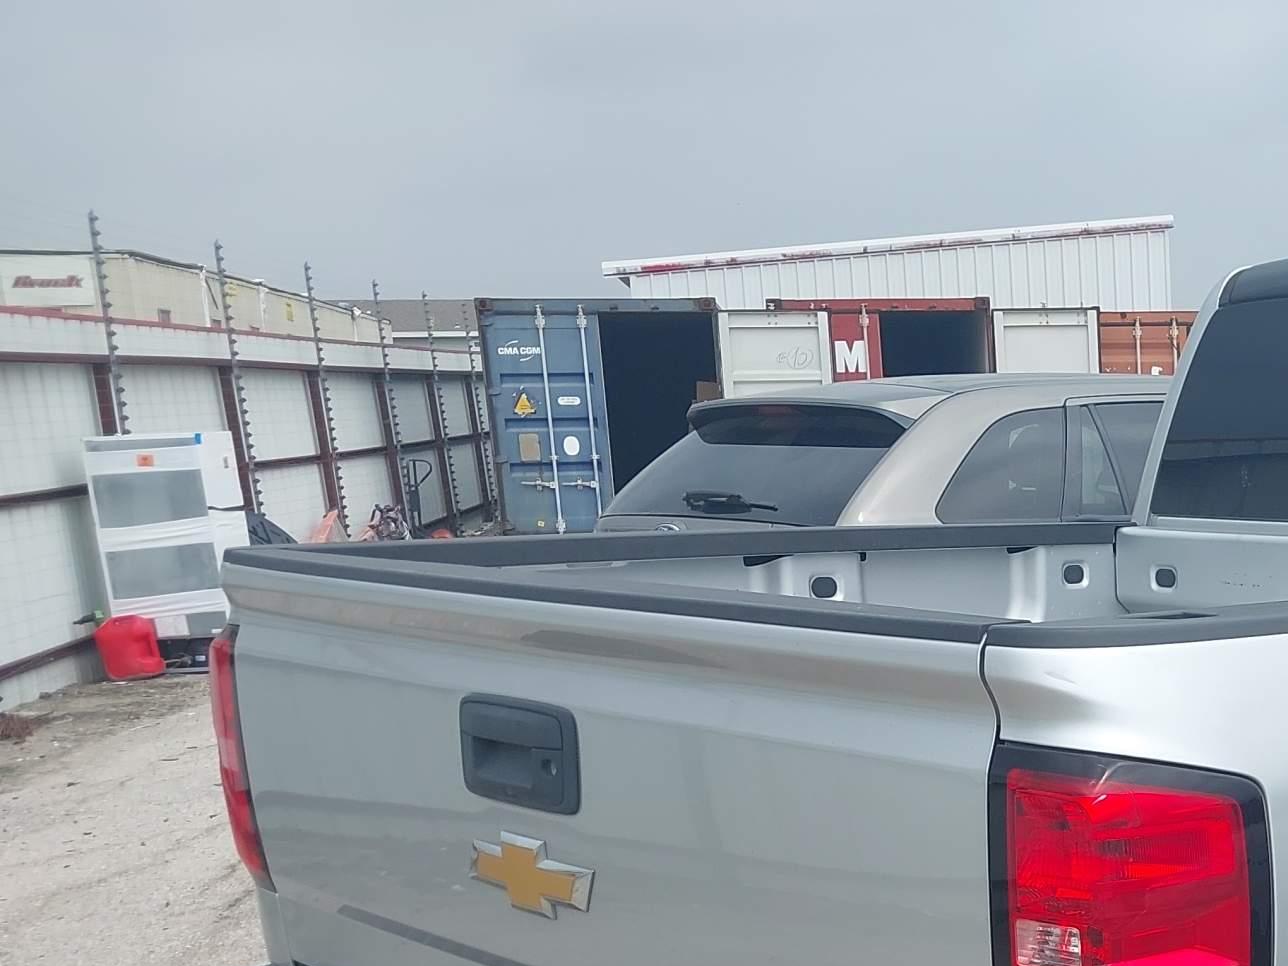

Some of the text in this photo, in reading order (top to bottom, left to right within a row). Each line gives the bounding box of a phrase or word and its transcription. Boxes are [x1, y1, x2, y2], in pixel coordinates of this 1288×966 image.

[498, 346, 541, 355] CMA CGM
[834, 340, 867, 373] M
